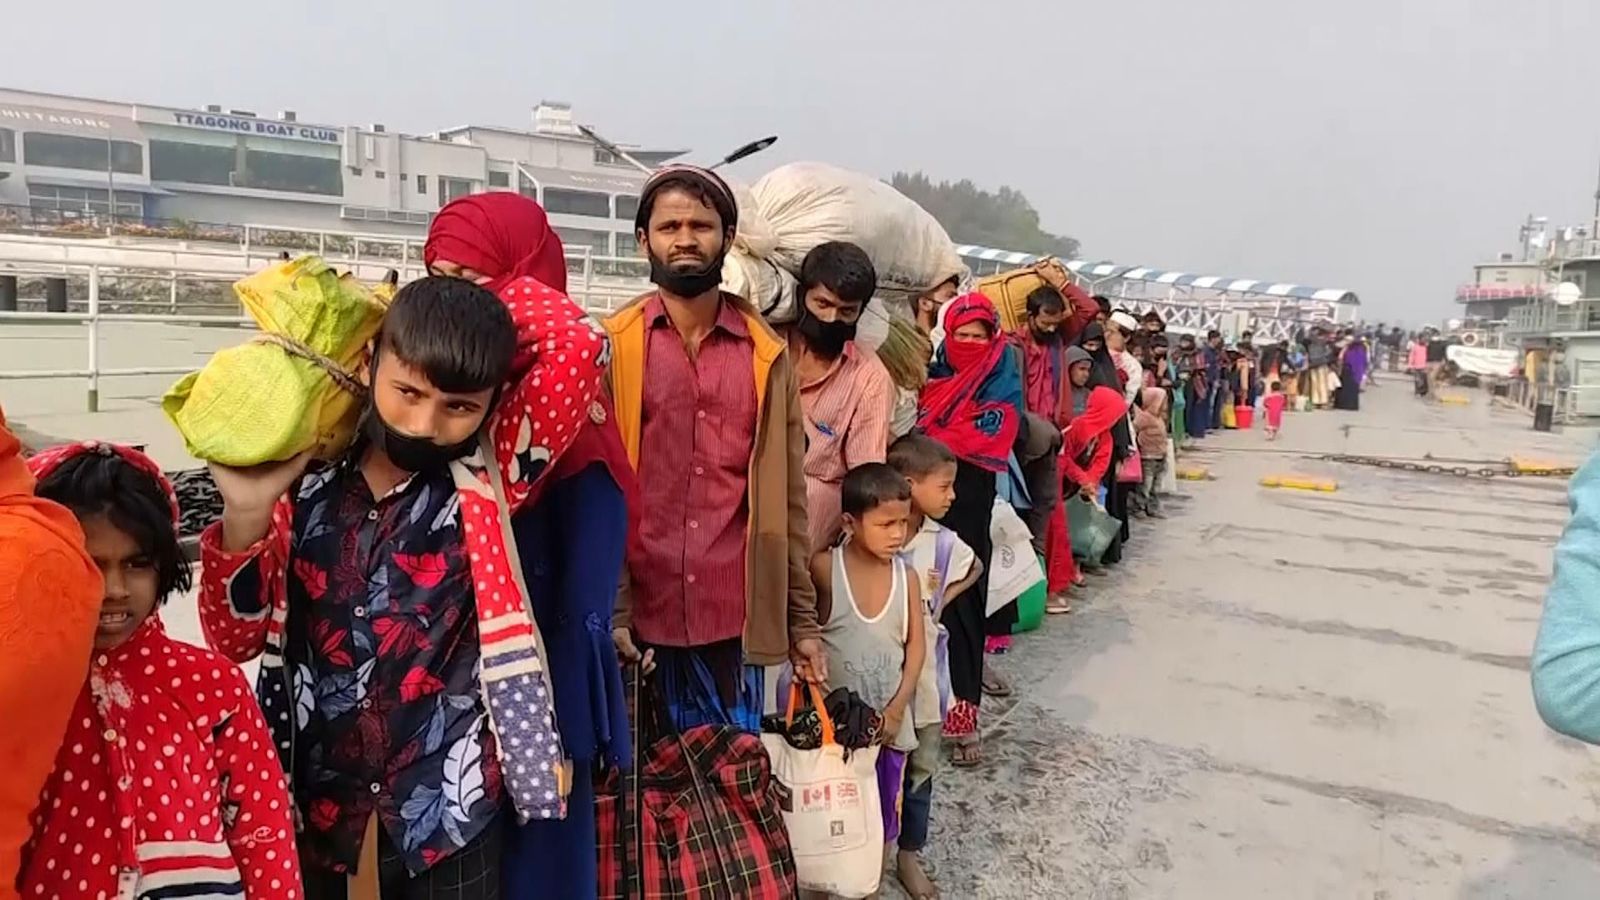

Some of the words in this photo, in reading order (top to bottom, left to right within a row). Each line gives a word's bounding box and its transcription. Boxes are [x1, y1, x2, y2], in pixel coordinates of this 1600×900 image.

[173, 113, 250, 131] TTAGONG
[255, 123, 295, 136] BOAT
[300, 129, 338, 142] CLUB
